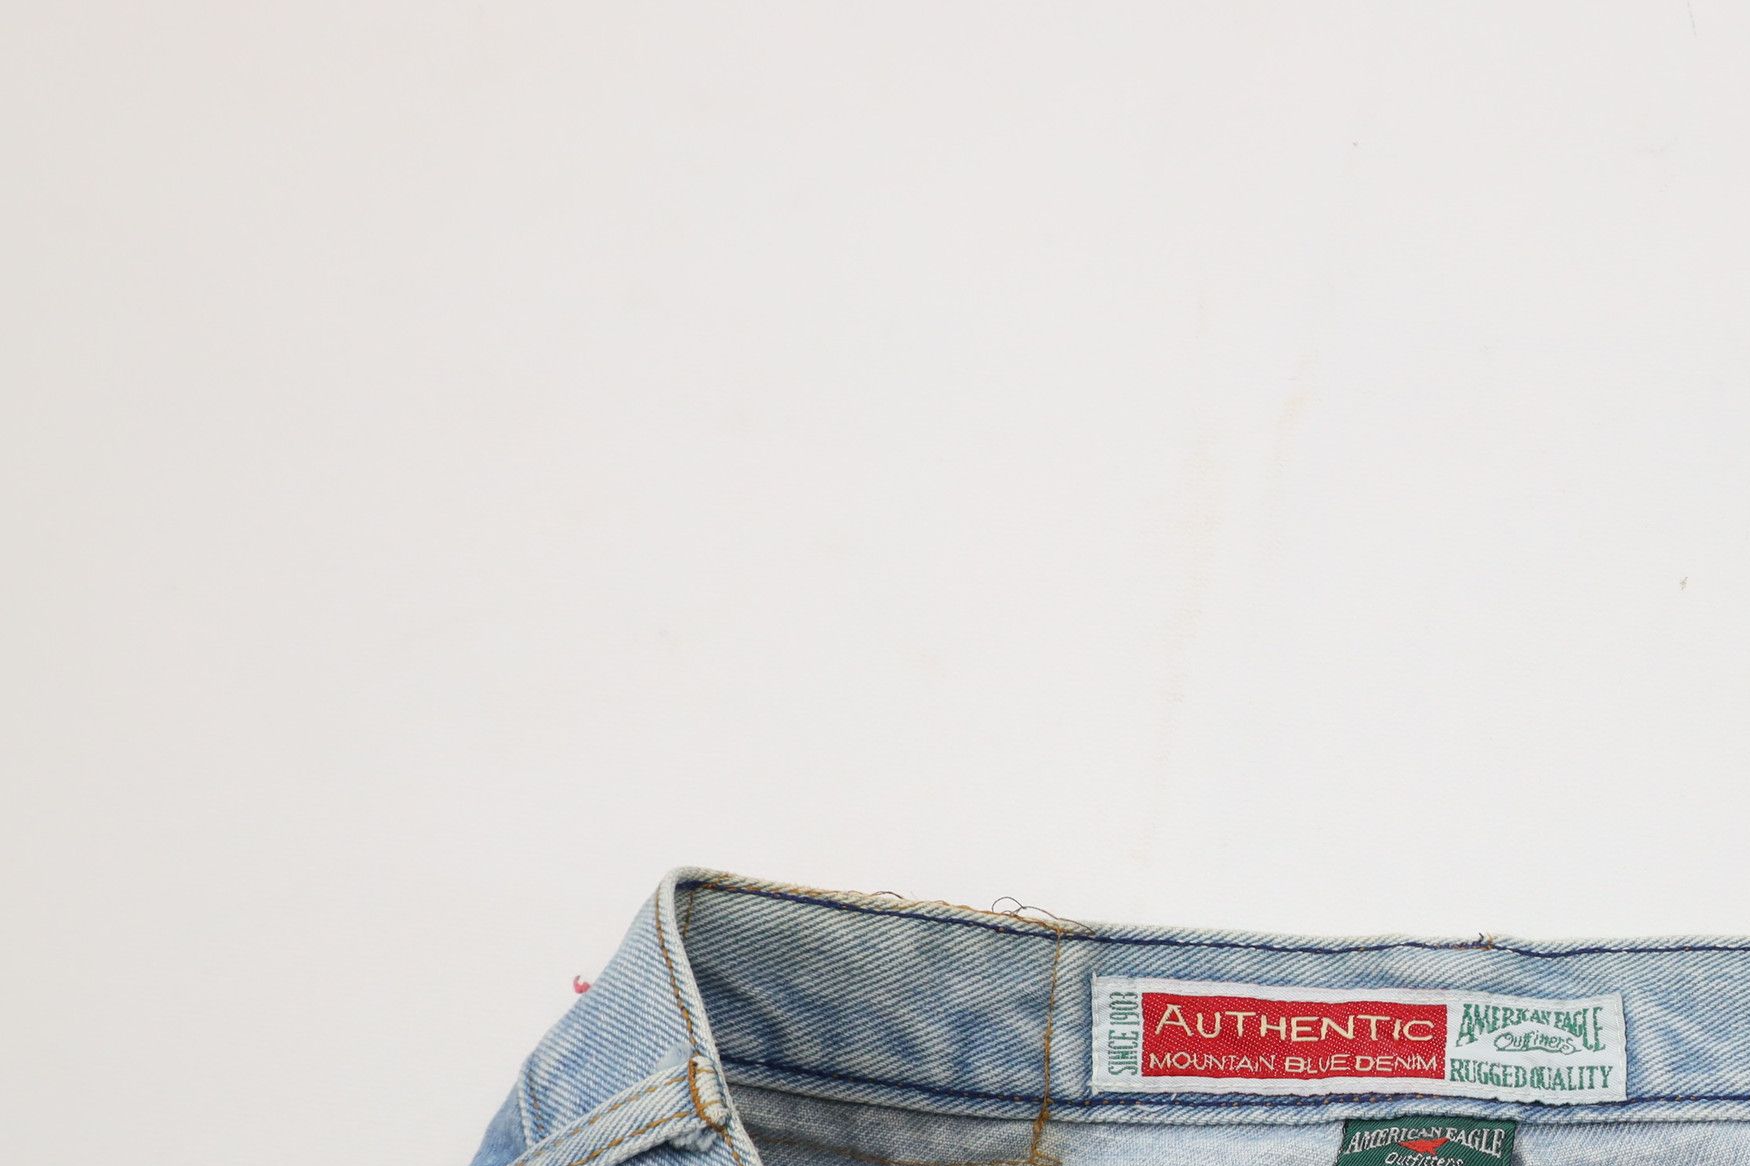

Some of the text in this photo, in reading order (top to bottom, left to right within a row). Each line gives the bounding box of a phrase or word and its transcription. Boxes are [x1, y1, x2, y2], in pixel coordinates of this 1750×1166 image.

[1154, 1003, 1434, 1042] AUTHENTIC
[1456, 1003, 1606, 1050] AMERICAN EAGLE
[1108, 1029, 1140, 1076] SINCE
[1149, 1050, 1437, 1074] MOUNTAIN BLUE DENIM
[1449, 1057, 1613, 1091] RUGGED QUALITY
[1343, 1126, 1505, 1159] AMERICAN EAGLE
